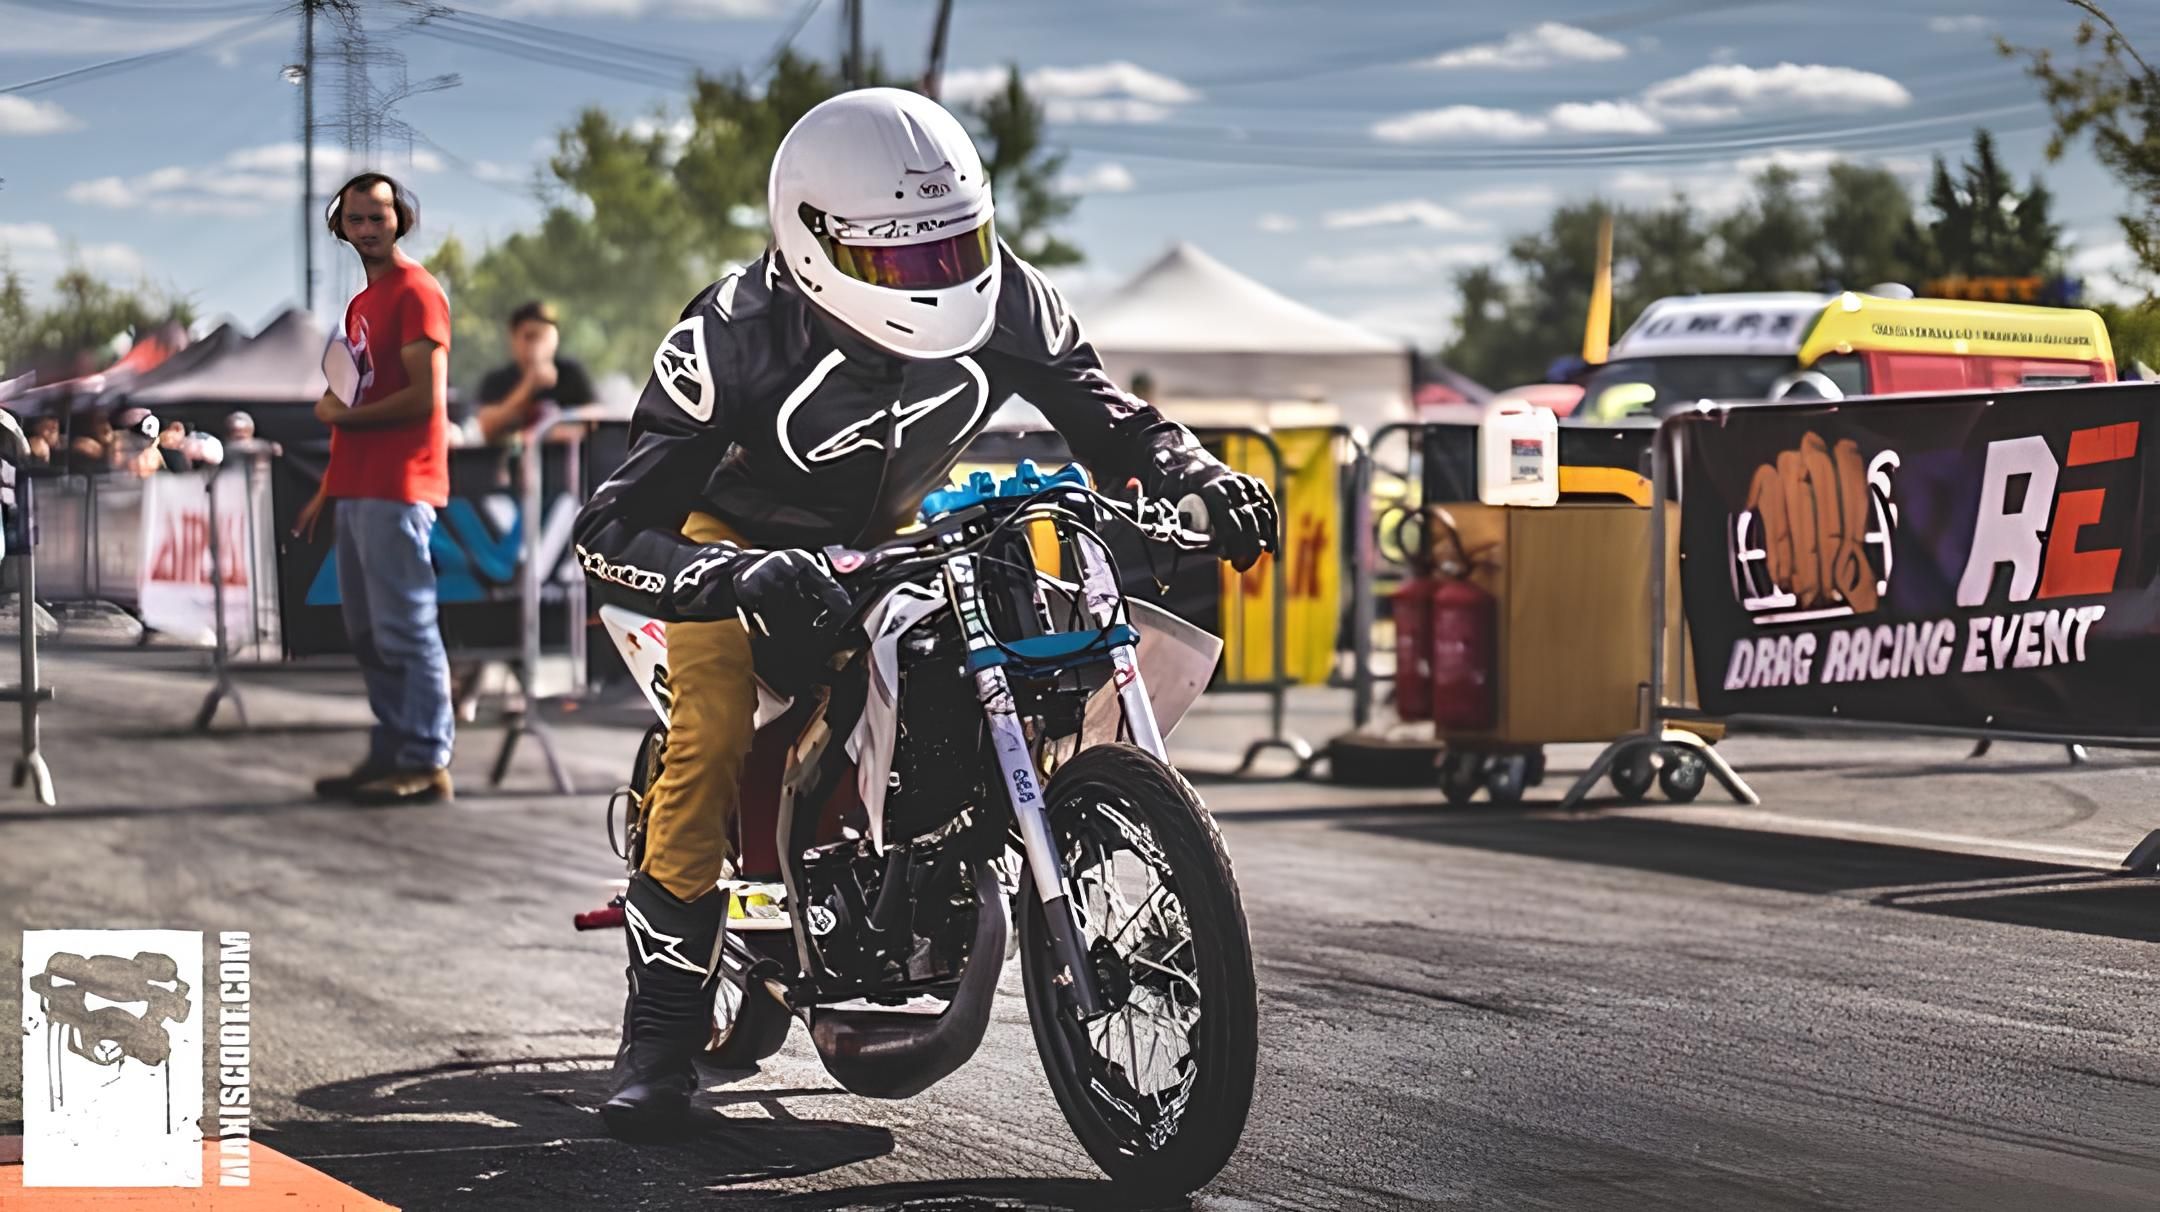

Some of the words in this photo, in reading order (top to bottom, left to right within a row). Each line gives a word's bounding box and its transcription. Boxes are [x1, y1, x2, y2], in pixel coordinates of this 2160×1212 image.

[1724, 633, 1817, 690] DRAG
[1821, 619, 1956, 684] RACING
[1962, 605, 2106, 673] EVENT
